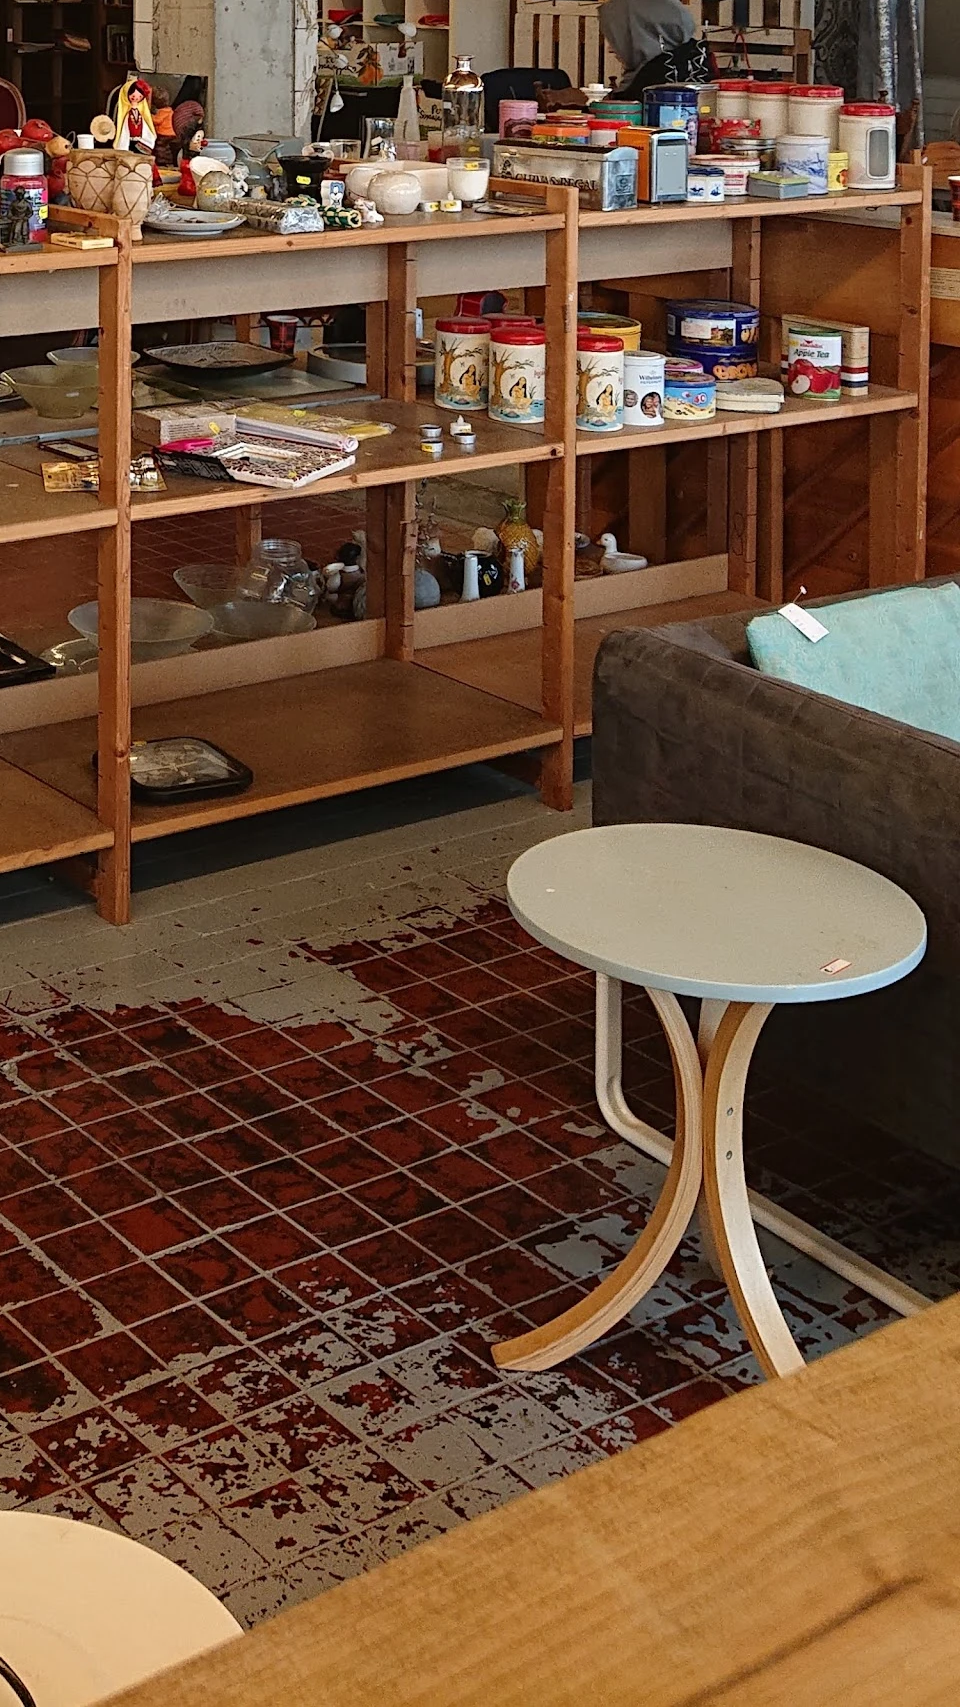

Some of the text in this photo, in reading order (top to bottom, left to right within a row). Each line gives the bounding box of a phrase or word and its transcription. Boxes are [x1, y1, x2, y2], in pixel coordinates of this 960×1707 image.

[559, 177, 599, 192] REGAL
[793, 348, 830, 359] Apple Tea
